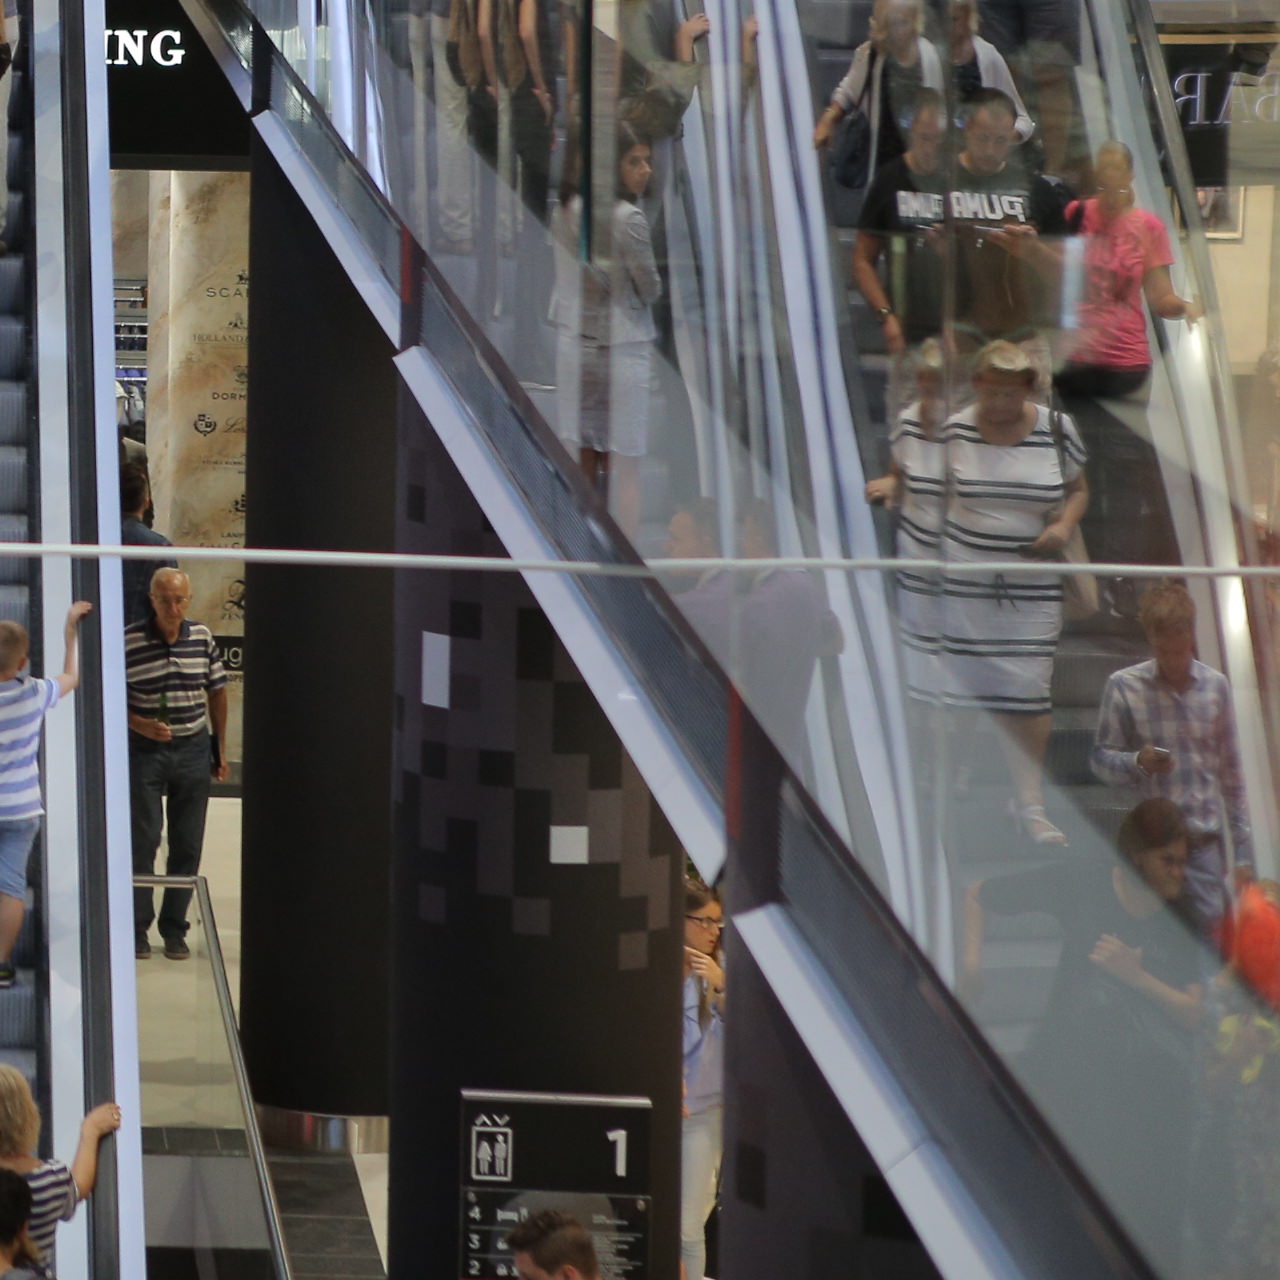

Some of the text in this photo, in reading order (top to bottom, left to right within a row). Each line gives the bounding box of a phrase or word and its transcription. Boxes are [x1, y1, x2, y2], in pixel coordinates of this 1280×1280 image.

[606, 1128, 627, 1177] 1
[468, 1233, 481, 1250] 3
[468, 1260, 481, 1277] 2
